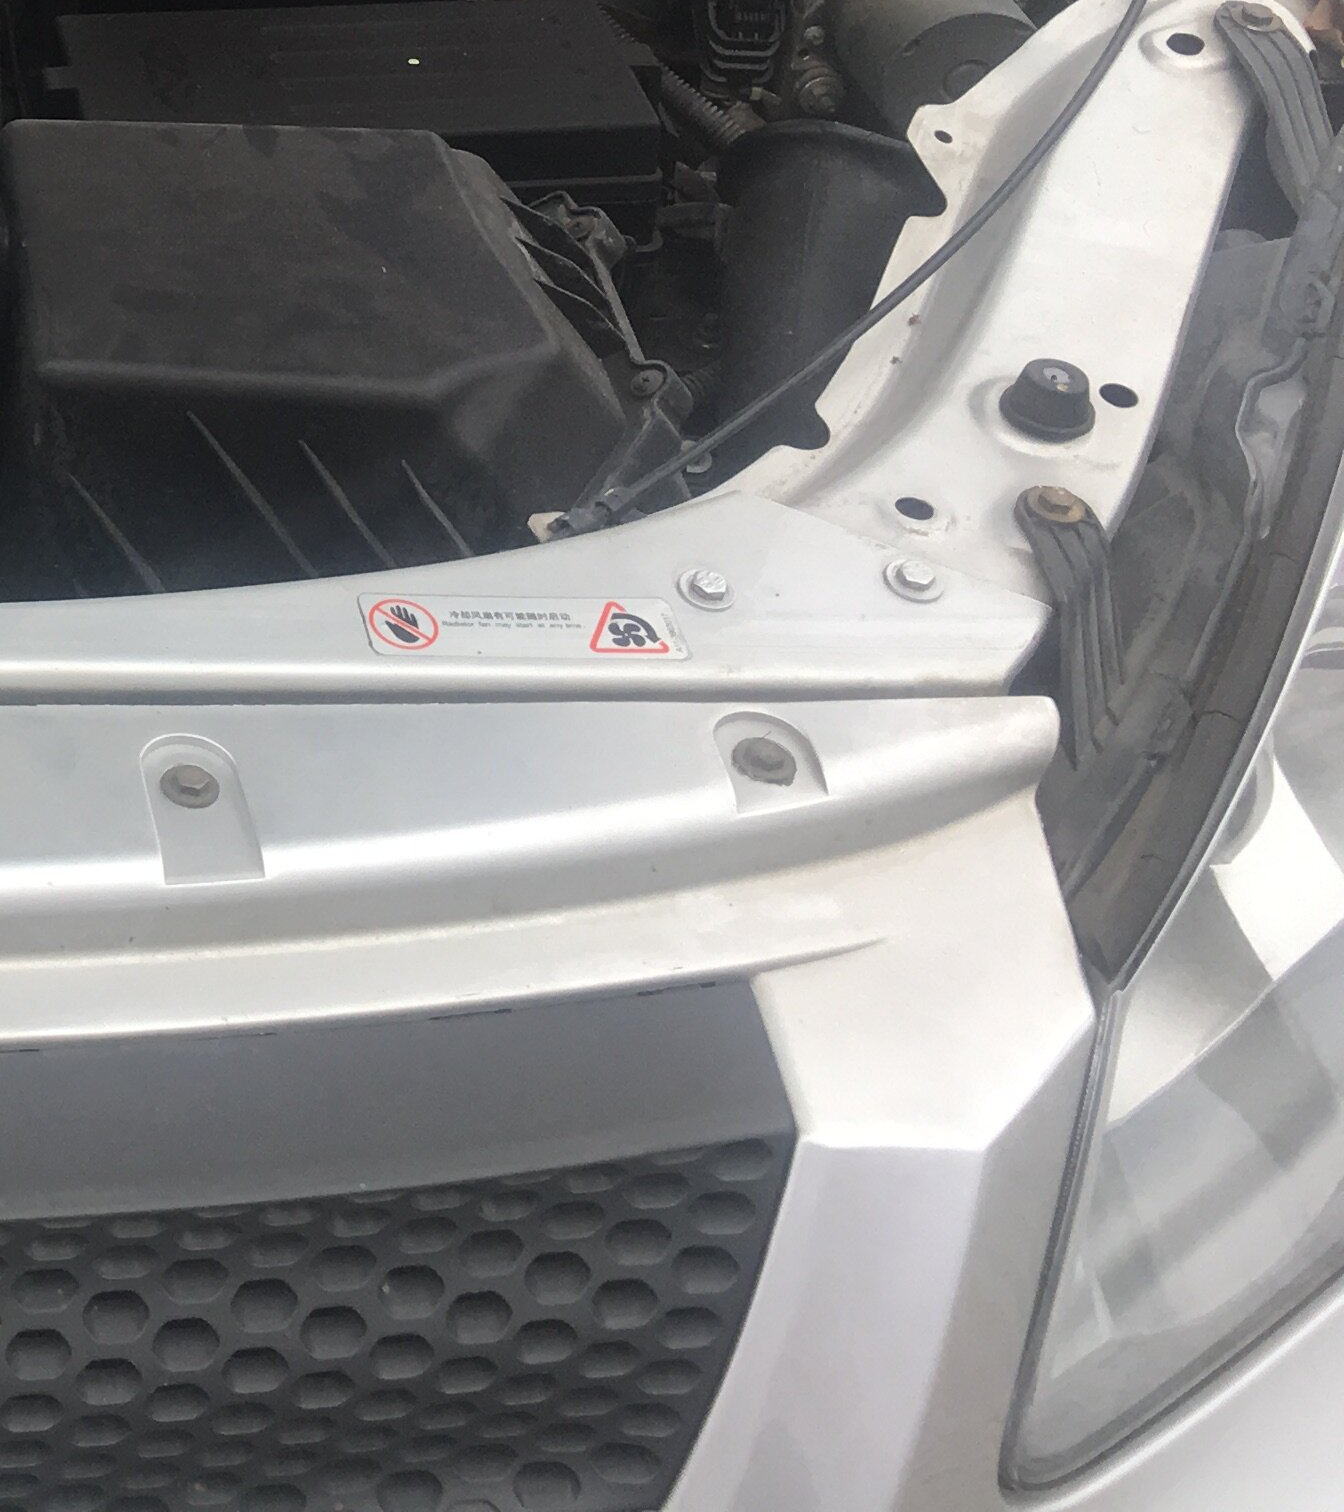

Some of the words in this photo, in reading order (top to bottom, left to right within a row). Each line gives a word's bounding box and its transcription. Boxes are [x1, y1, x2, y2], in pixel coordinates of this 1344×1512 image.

[448, 610, 572, 621] 冷却风扇有可能随时启动
